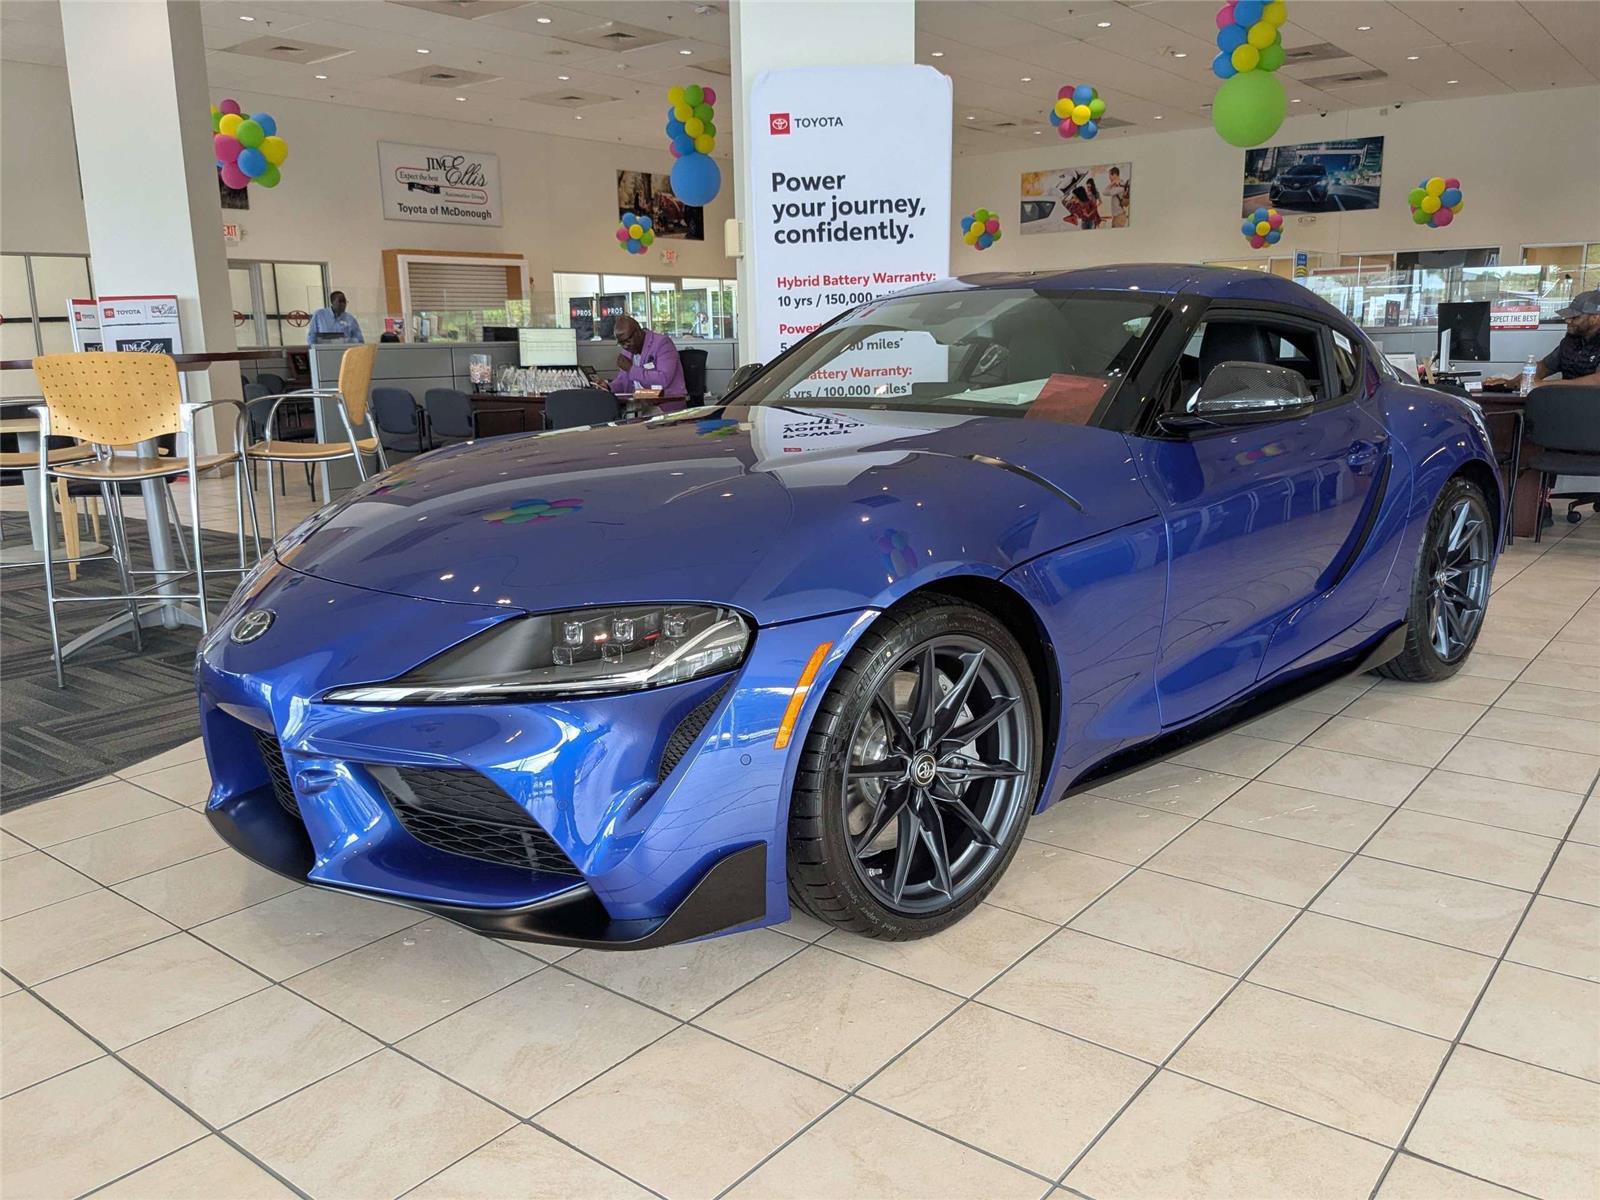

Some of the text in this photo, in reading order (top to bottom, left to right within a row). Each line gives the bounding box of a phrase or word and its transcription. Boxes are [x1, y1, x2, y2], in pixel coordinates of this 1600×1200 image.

[794, 117, 843, 128] TOYOTA
[425, 155, 487, 187] JIM Ellis
[772, 172, 846, 192] Power
[397, 203, 492, 220] Toyota of McDonough
[772, 195, 926, 224] your journey,
[774, 219, 914, 244] confidently.
[777, 271, 936, 290] Hybrid Battery Warranty:
[778, 296, 791, 307] 10
[794, 297, 813, 309] yrs
[816, 294, 822, 307] /
[825, 292, 873, 307] 150,000
[576, 309, 592, 317] PROS
[608, 307, 623, 315] PROS
[807, 366, 912, 381] attery Warranty:
[794, 390, 812, 398] yrs
[824, 385, 871, 397] 100,000
